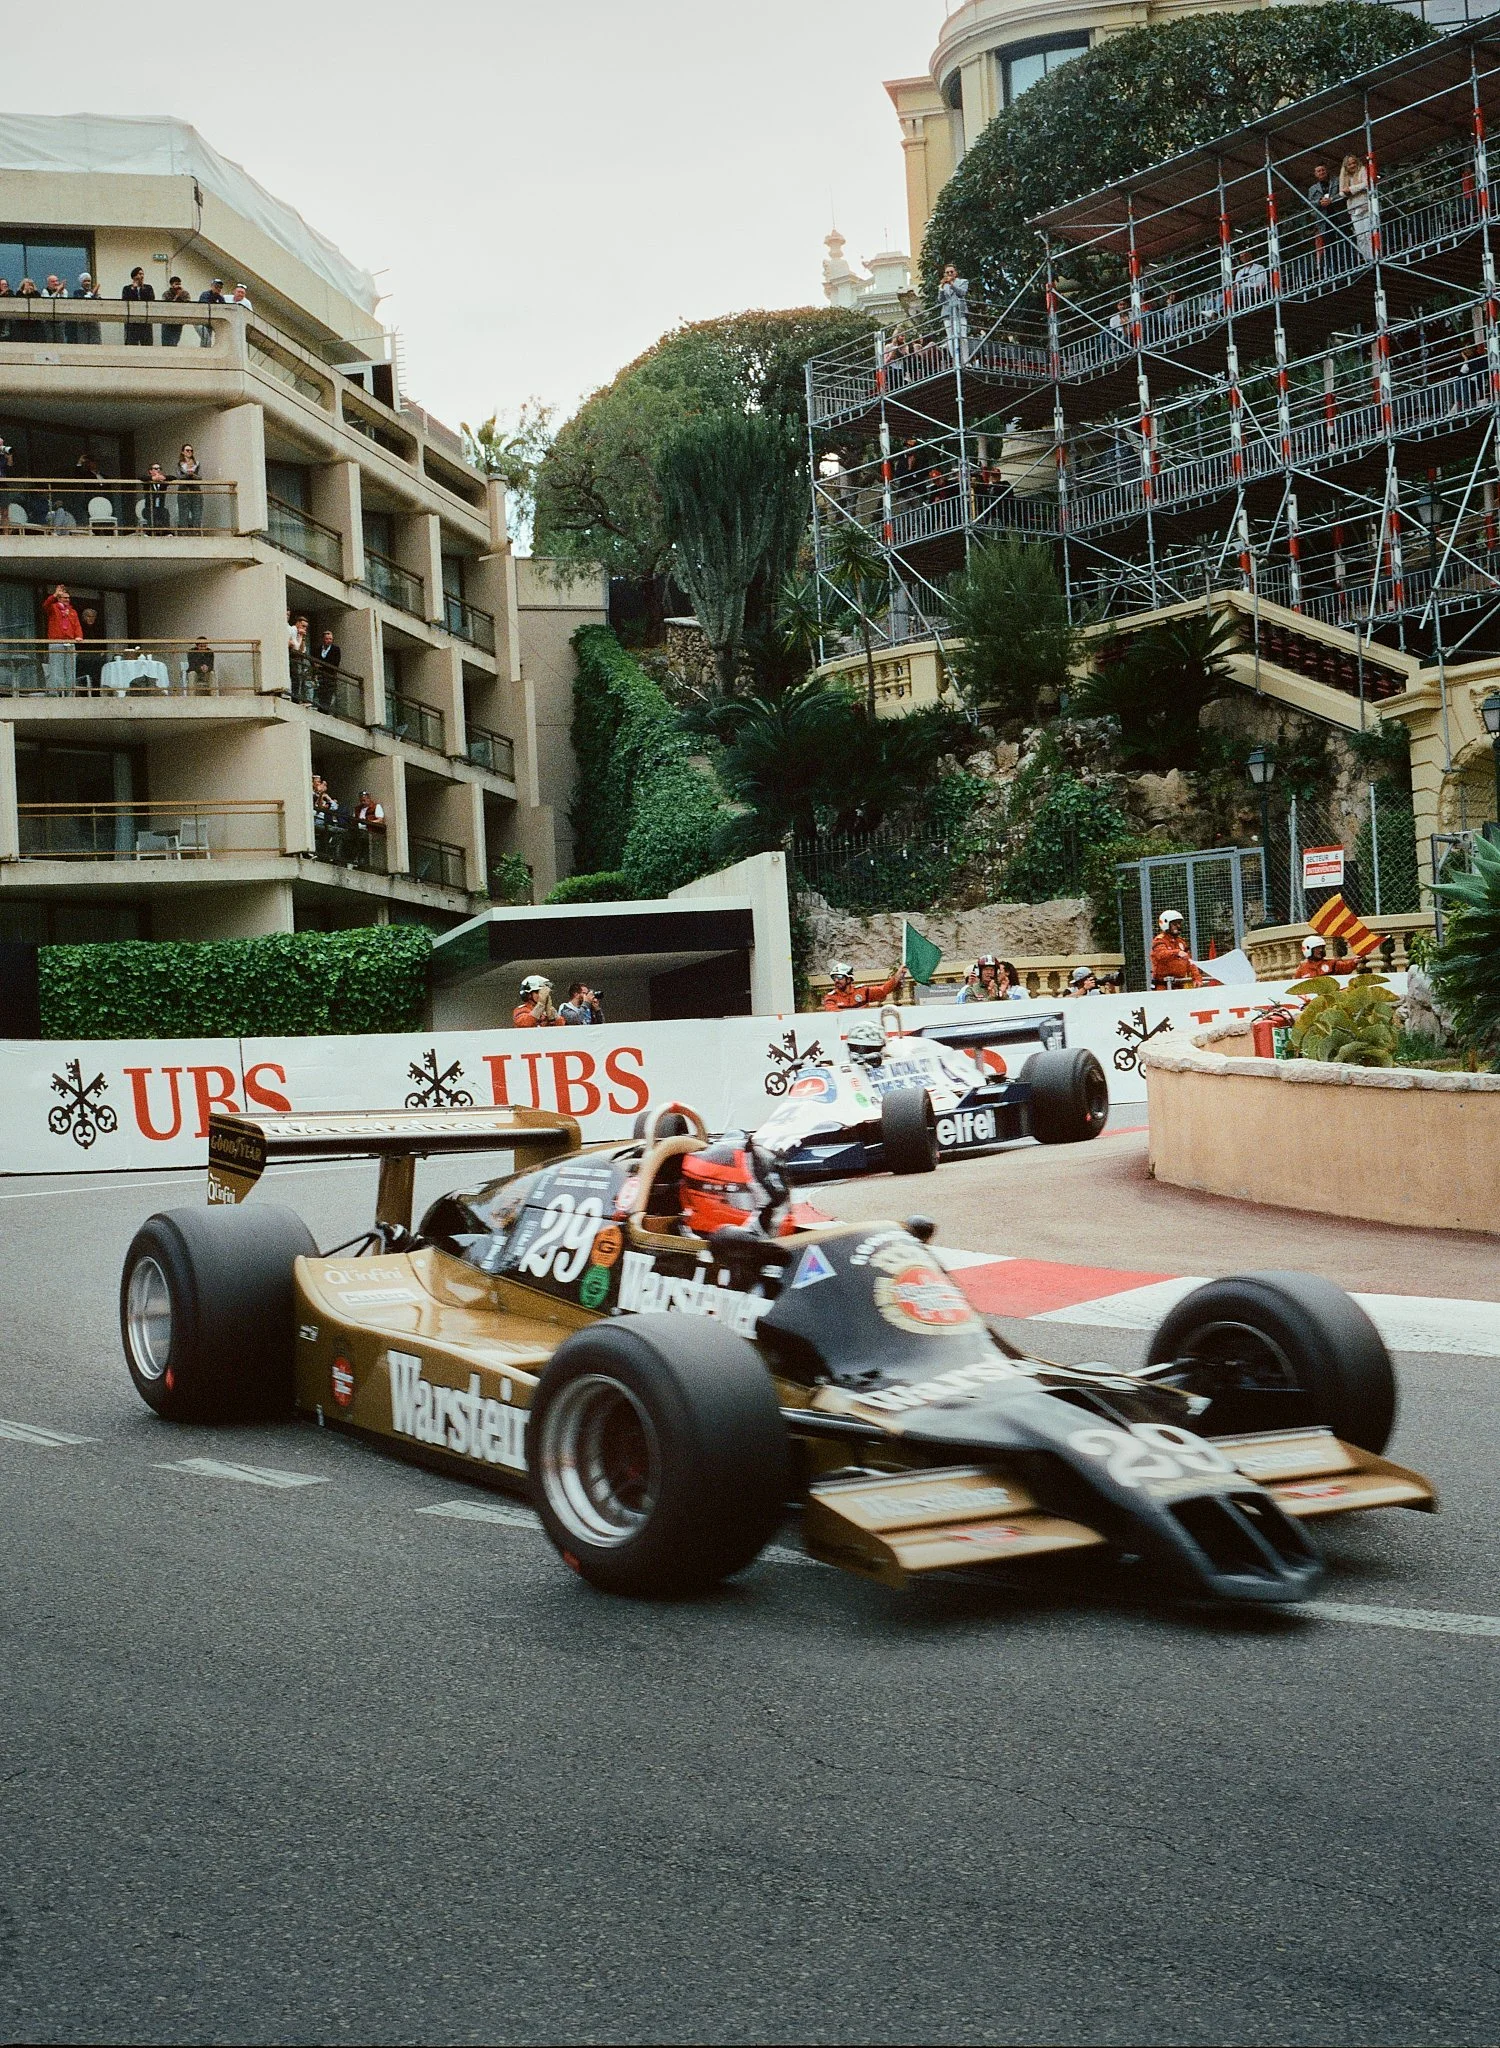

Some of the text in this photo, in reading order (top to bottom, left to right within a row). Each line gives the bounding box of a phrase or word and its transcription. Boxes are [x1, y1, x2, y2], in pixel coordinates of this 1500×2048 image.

[123, 1062, 292, 1141] UBS
[482, 1046, 650, 1117] UBS
[211, 1136, 262, 1169] GOODYEAR
[518, 1193, 604, 1283] 29
[1067, 1422, 1237, 1489] 29
